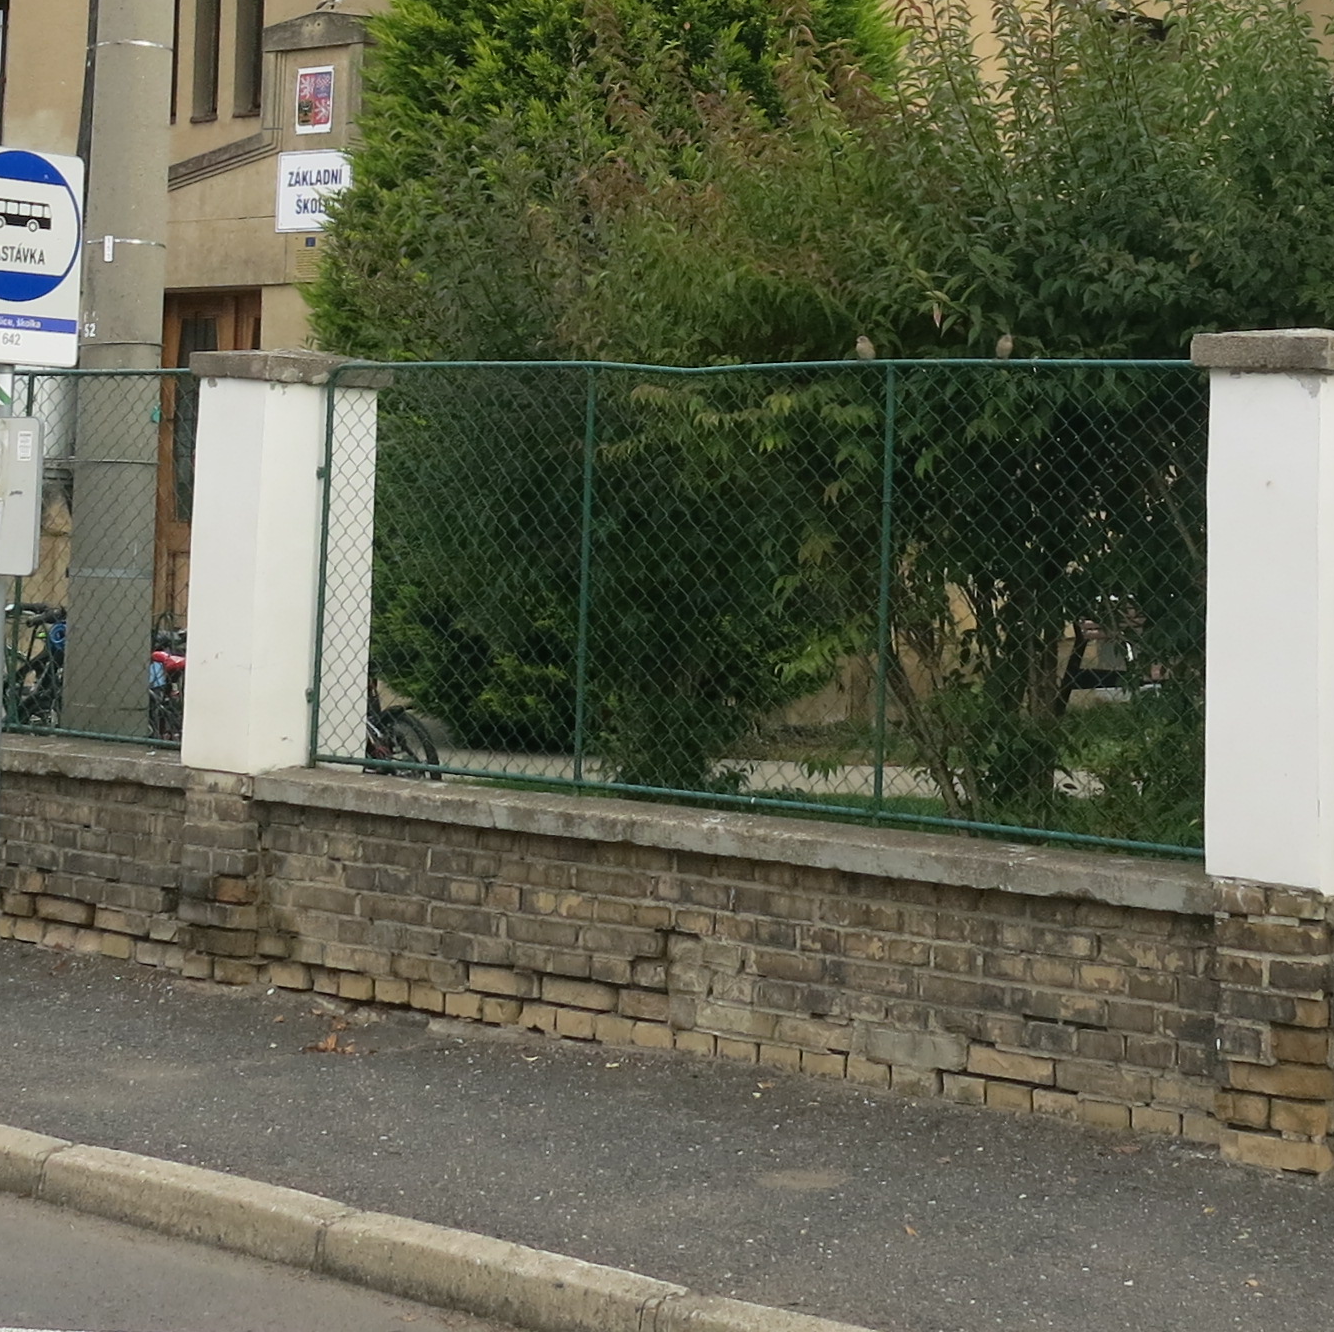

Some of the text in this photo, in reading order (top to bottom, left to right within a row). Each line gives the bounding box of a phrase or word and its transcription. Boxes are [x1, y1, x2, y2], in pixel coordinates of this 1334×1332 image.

[287, 163, 343, 187] ZÁKLADNÍ
[295, 193, 329, 215] ŠKOL
[2, 332, 22, 346] 642
